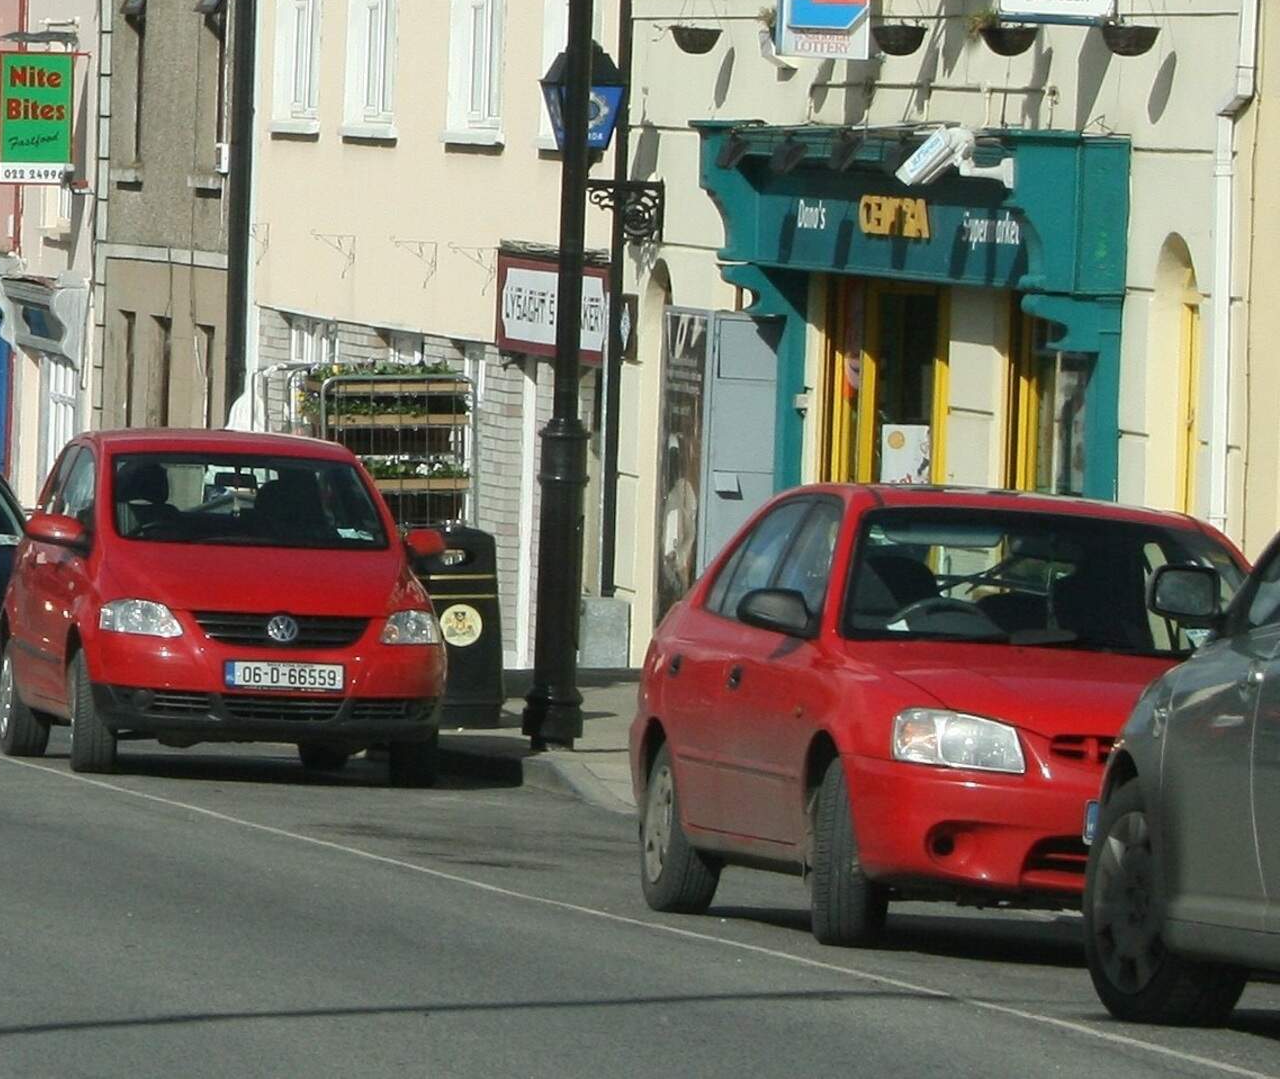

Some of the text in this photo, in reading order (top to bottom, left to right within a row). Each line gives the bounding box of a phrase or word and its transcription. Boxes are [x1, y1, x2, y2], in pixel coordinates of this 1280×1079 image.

[794, 40, 852, 53] LOTTERY
[10, 66, 62, 88] Nite
[6, 98, 65, 121] Bites
[4, 169, 25, 179] 022
[797, 199, 826, 230] Dano's
[859, 194, 930, 239] CENTRA
[962, 211, 1021, 251] Supermarket
[242, 666, 337, 687] 06-D-66559
